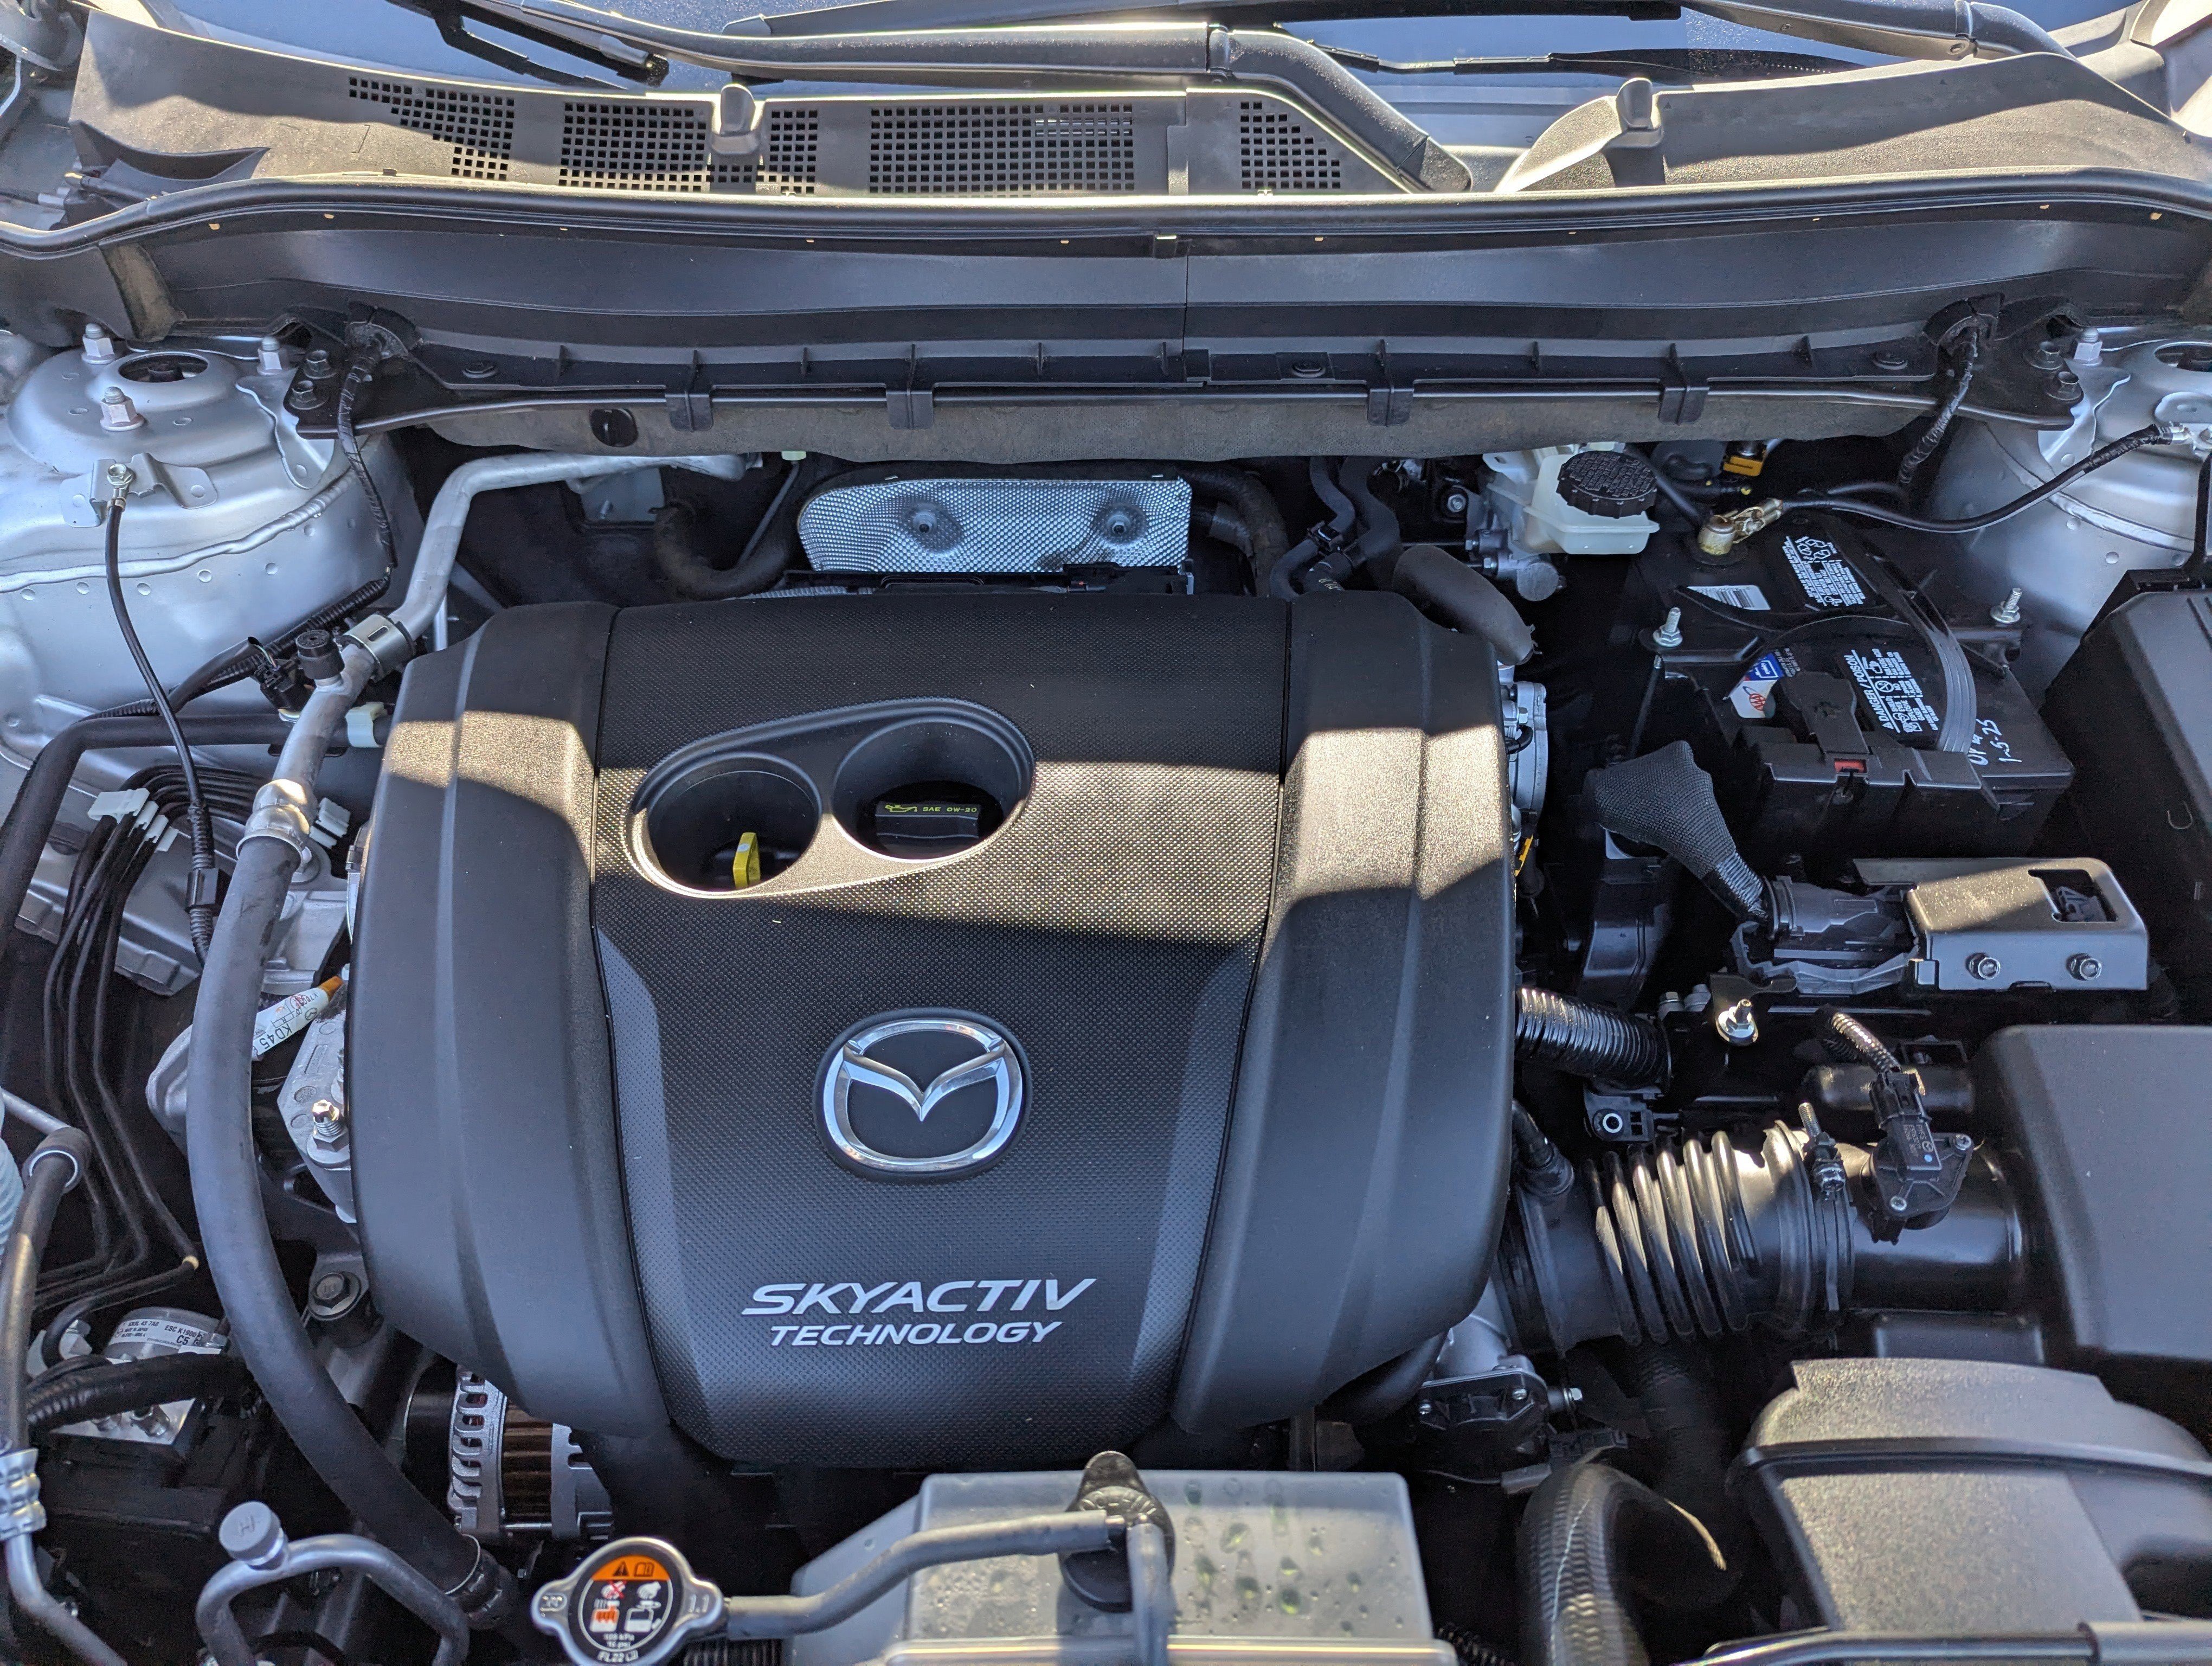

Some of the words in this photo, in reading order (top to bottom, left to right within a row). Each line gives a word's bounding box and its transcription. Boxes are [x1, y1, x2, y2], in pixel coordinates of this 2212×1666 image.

[1843, 655, 1868, 682] POISON
[1863, 689, 1889, 722] DANGER
[259, 1023, 292, 1050] KD45
[741, 1277, 1097, 1316] SKYACTIV
[176, 1335, 190, 1345] C5
[770, 1321, 1064, 1347] TECHNOLOGY
